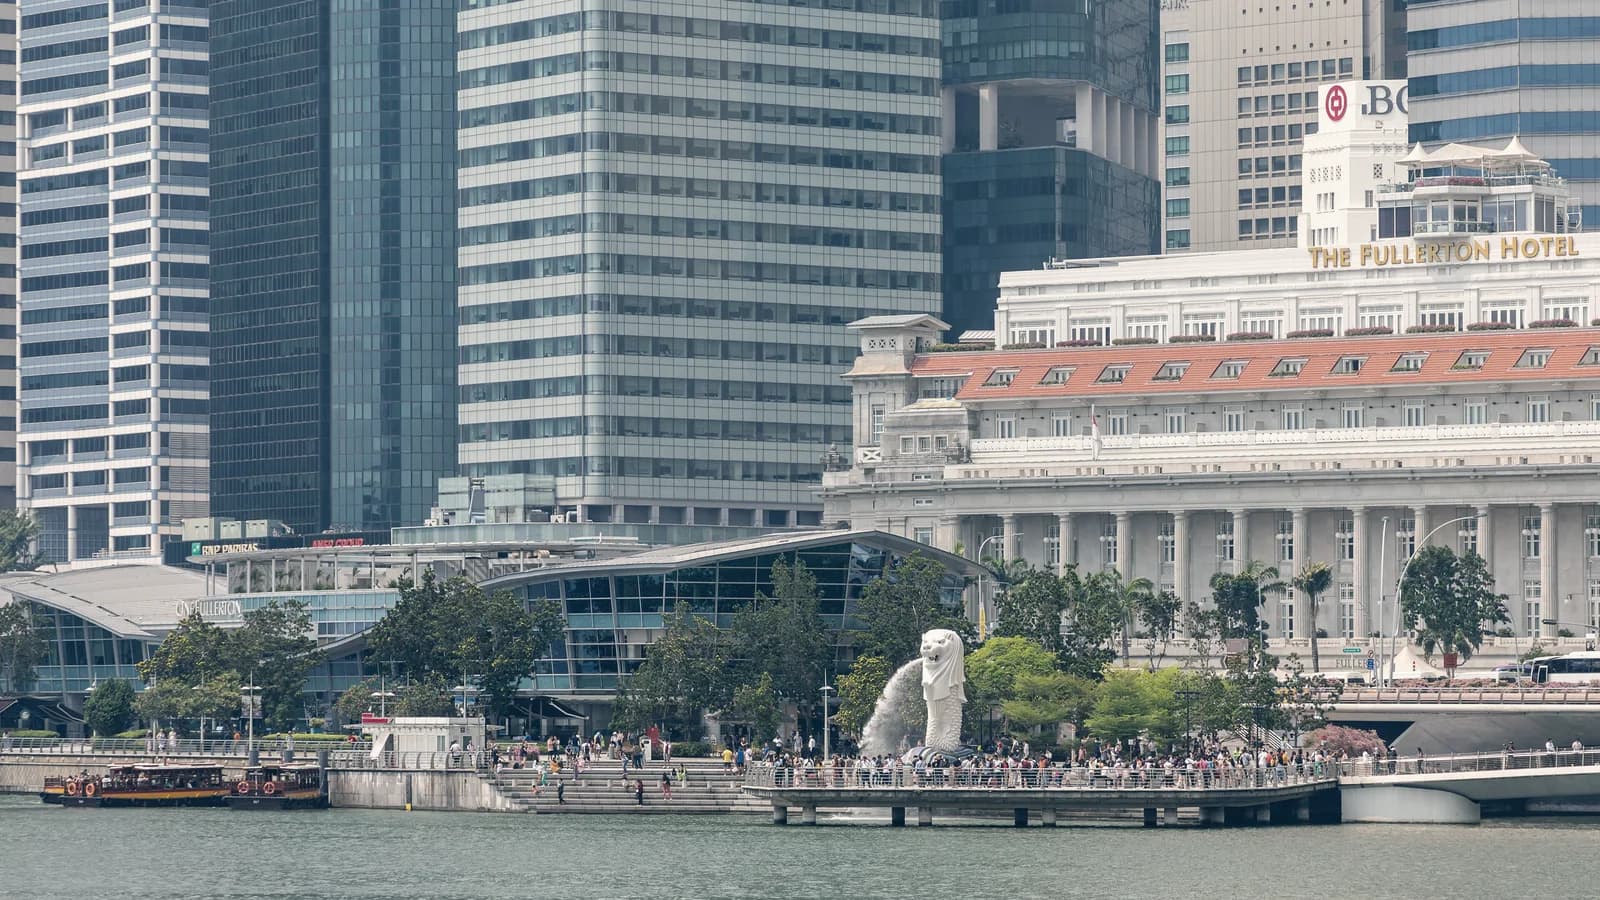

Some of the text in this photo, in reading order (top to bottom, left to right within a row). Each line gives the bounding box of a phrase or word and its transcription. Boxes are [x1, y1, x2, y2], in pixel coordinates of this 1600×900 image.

[1308, 236, 1580, 269] THE FULLERTON HOTEL
[195, 599, 242, 617] FULLERTON
